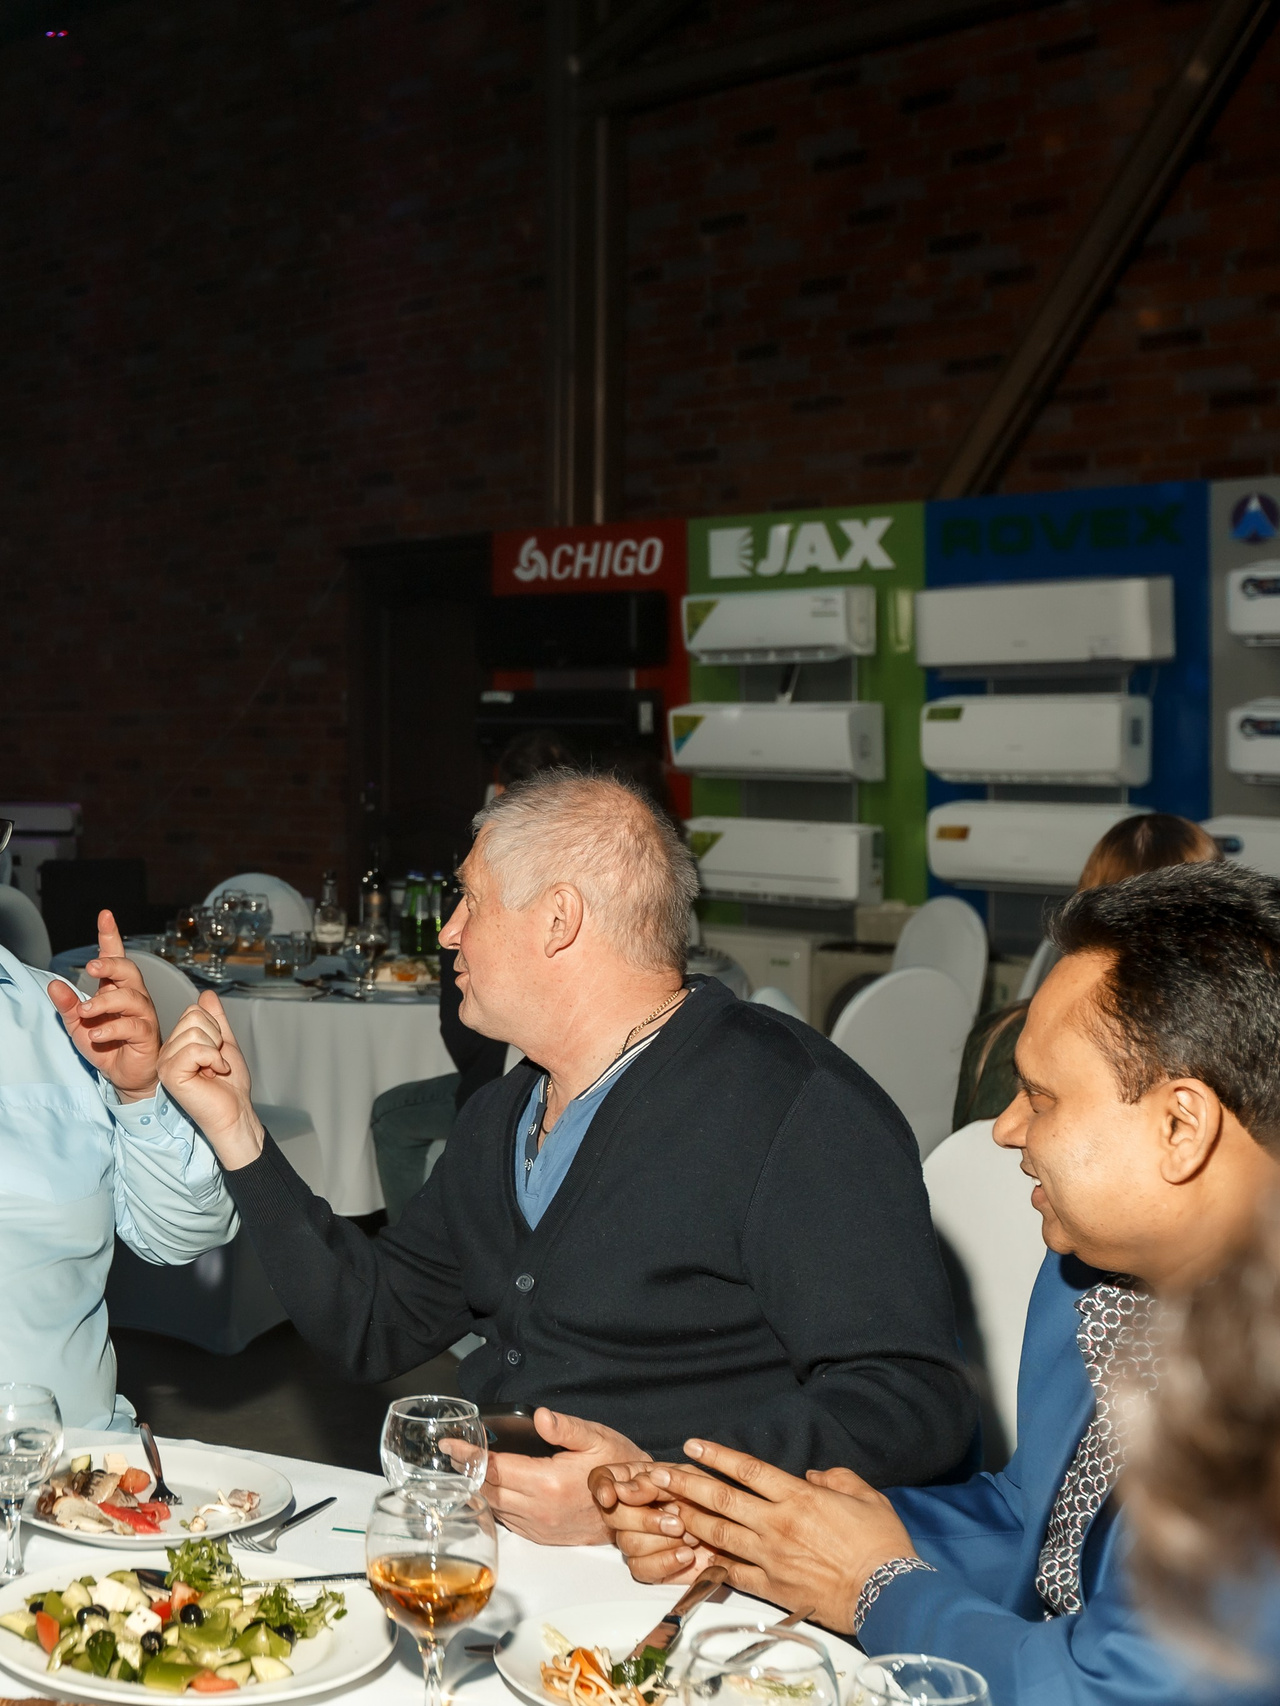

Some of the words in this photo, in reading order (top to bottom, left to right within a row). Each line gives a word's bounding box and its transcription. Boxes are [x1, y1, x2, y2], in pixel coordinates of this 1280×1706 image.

[756, 517, 896, 577] JAX
[941, 505, 1182, 556] ROVEX
[551, 537, 663, 580] CHIGO
